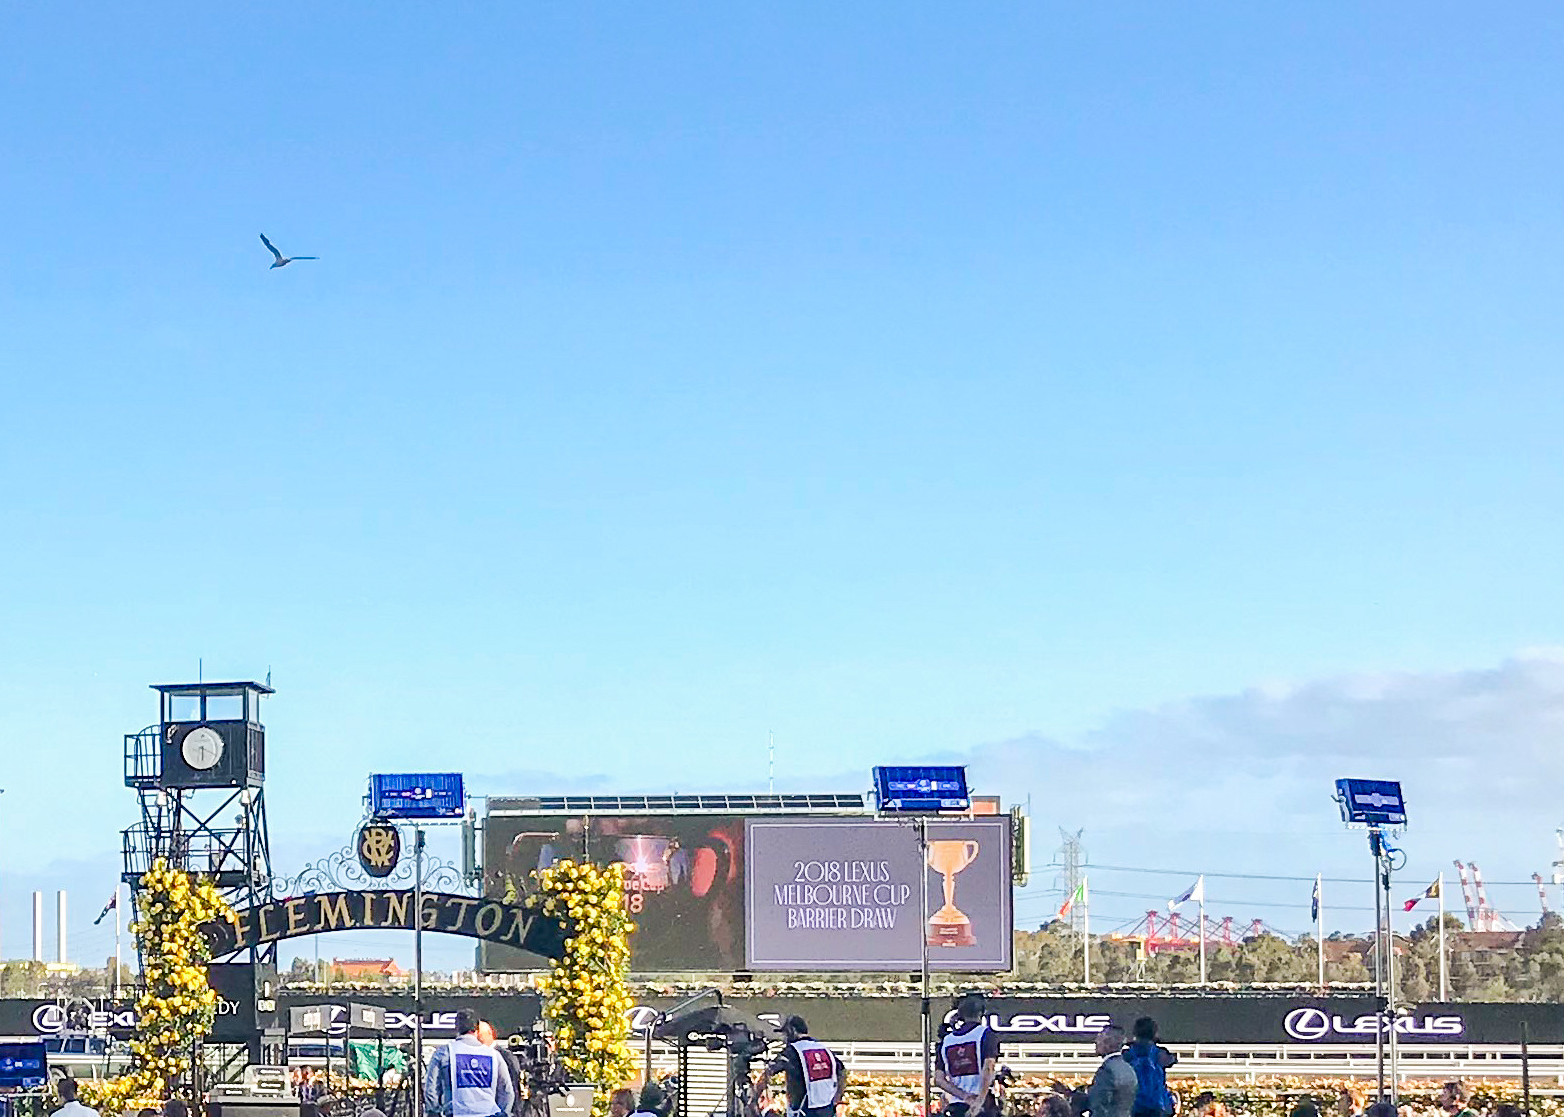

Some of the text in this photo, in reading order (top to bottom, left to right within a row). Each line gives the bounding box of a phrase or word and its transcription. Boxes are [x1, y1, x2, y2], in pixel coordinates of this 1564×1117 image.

[794, 861, 890, 883] 2018 LEXUS
[774, 884, 911, 906] MELBOURNE CUP
[233, 890, 538, 949] FLEMINGTON
[788, 907, 898, 929] BARRIER DRAW
[384, 1011, 458, 1029] EXUS
[989, 1014, 1112, 1032] LEXUS
[1332, 1015, 1464, 1034] LEXUS
